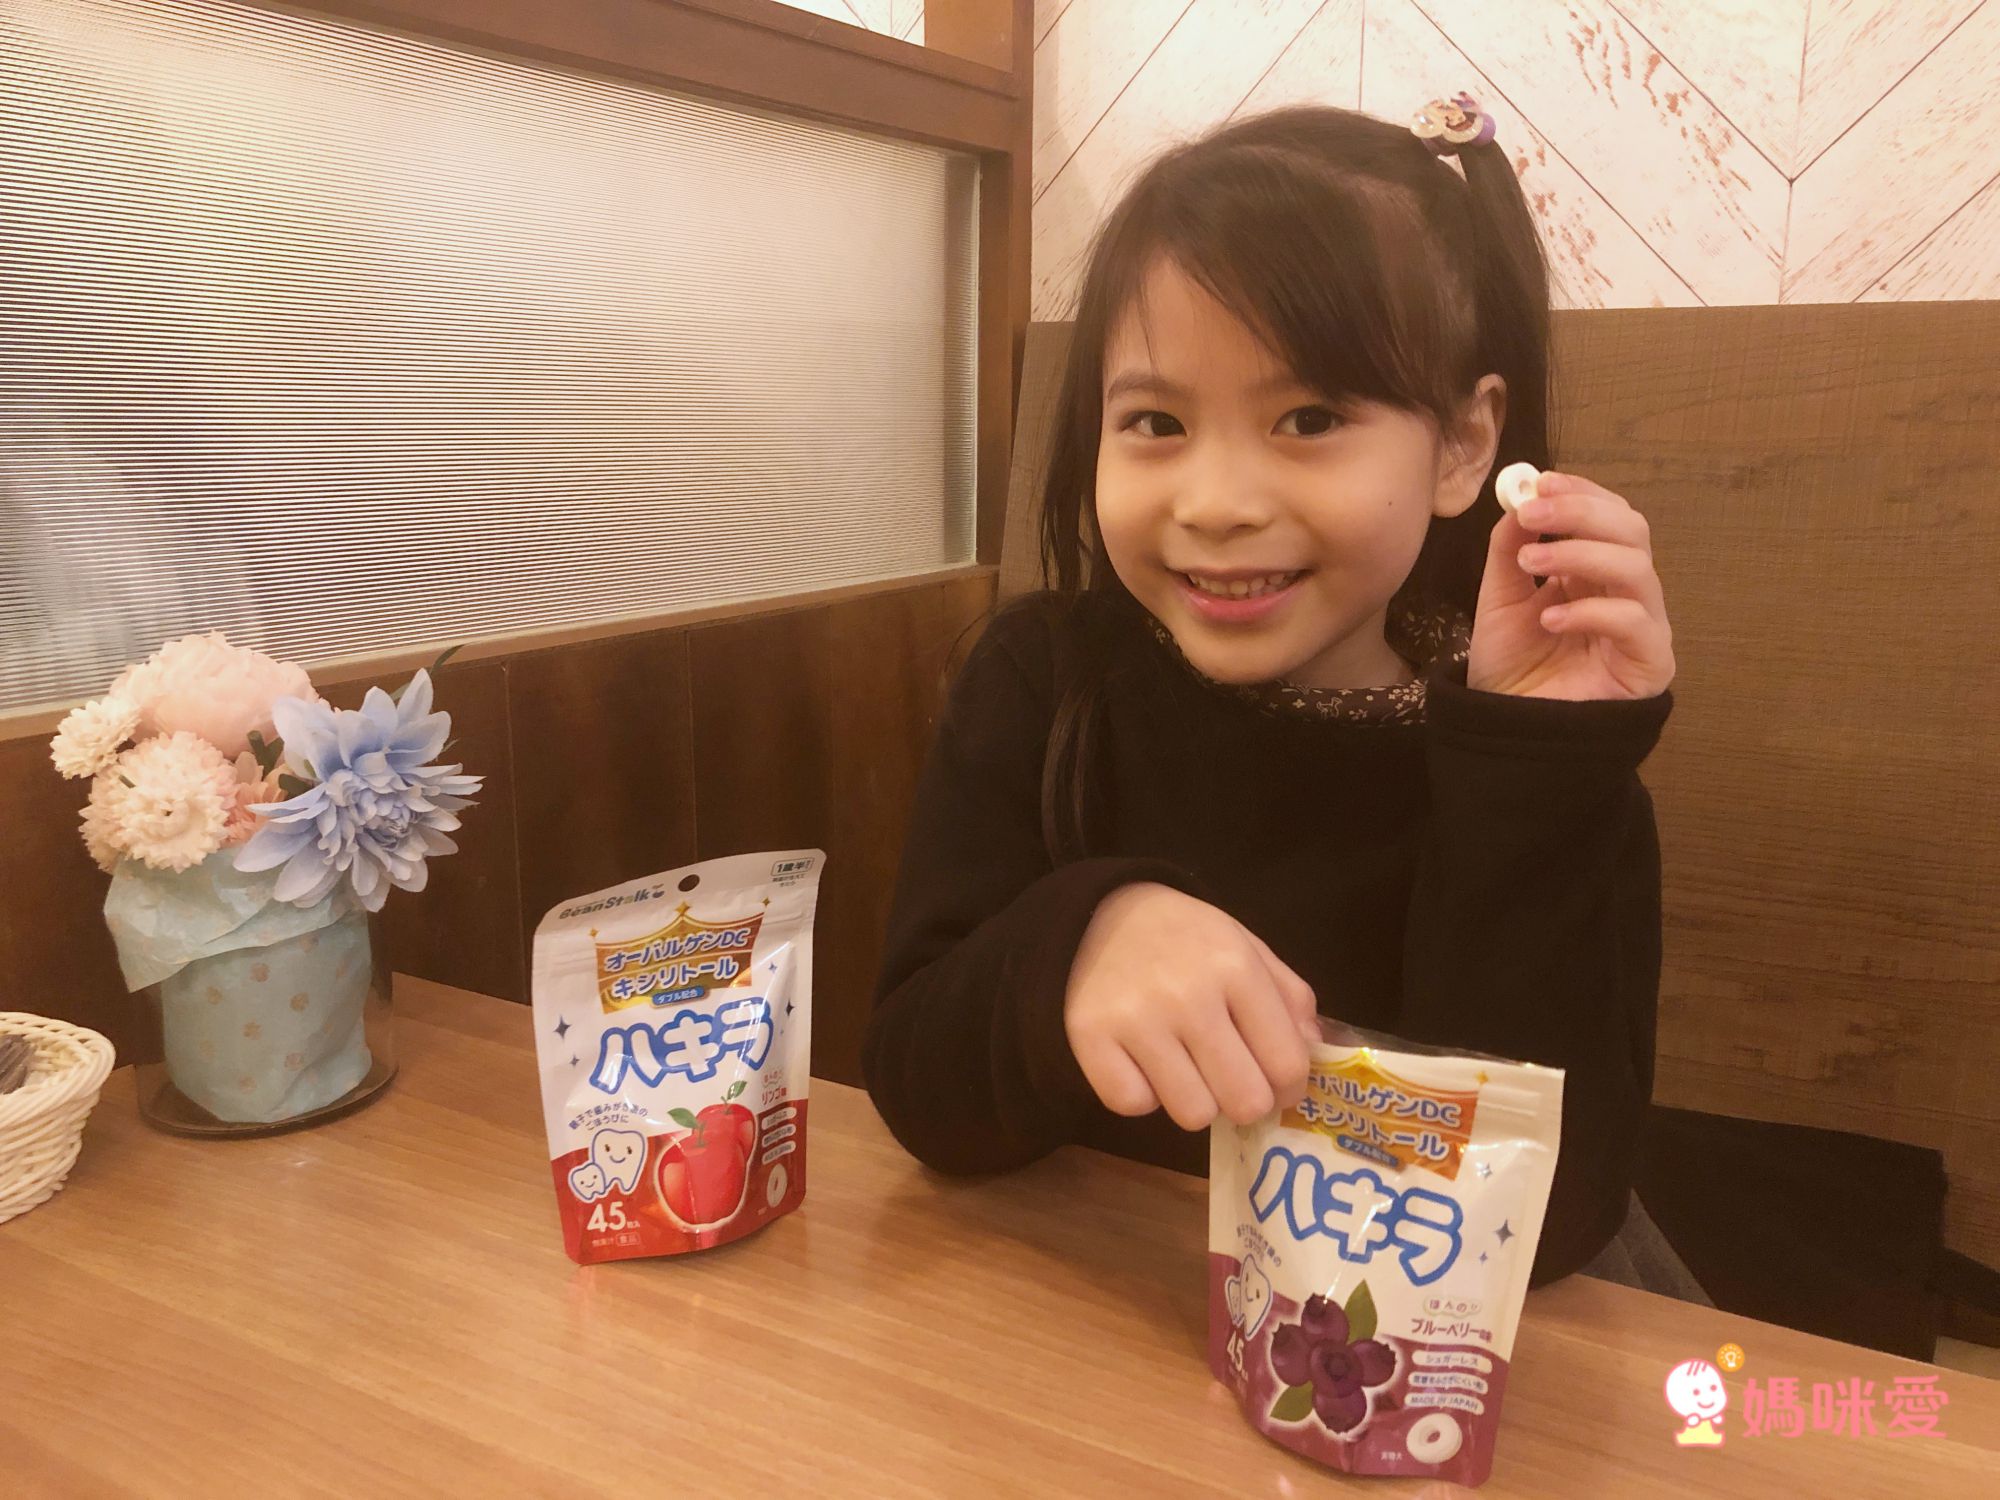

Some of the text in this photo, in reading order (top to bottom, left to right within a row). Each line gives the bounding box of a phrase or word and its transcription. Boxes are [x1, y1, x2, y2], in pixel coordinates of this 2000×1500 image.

[605, 929, 750, 971] オーバルゲンDC
[613, 958, 737, 1000] キシリトール
[590, 996, 774, 1095] ハキラ
[1307, 1074, 1461, 1126] ーバルゲンDC
[1299, 1096, 1447, 1159] キシリトール
[586, 1201, 626, 1233] 45
[1249, 1146, 1464, 1287] ハキラ
[1411, 1318, 1492, 1343] ブルーベリー味
[1450, 1397, 1479, 1411] JAPAN
